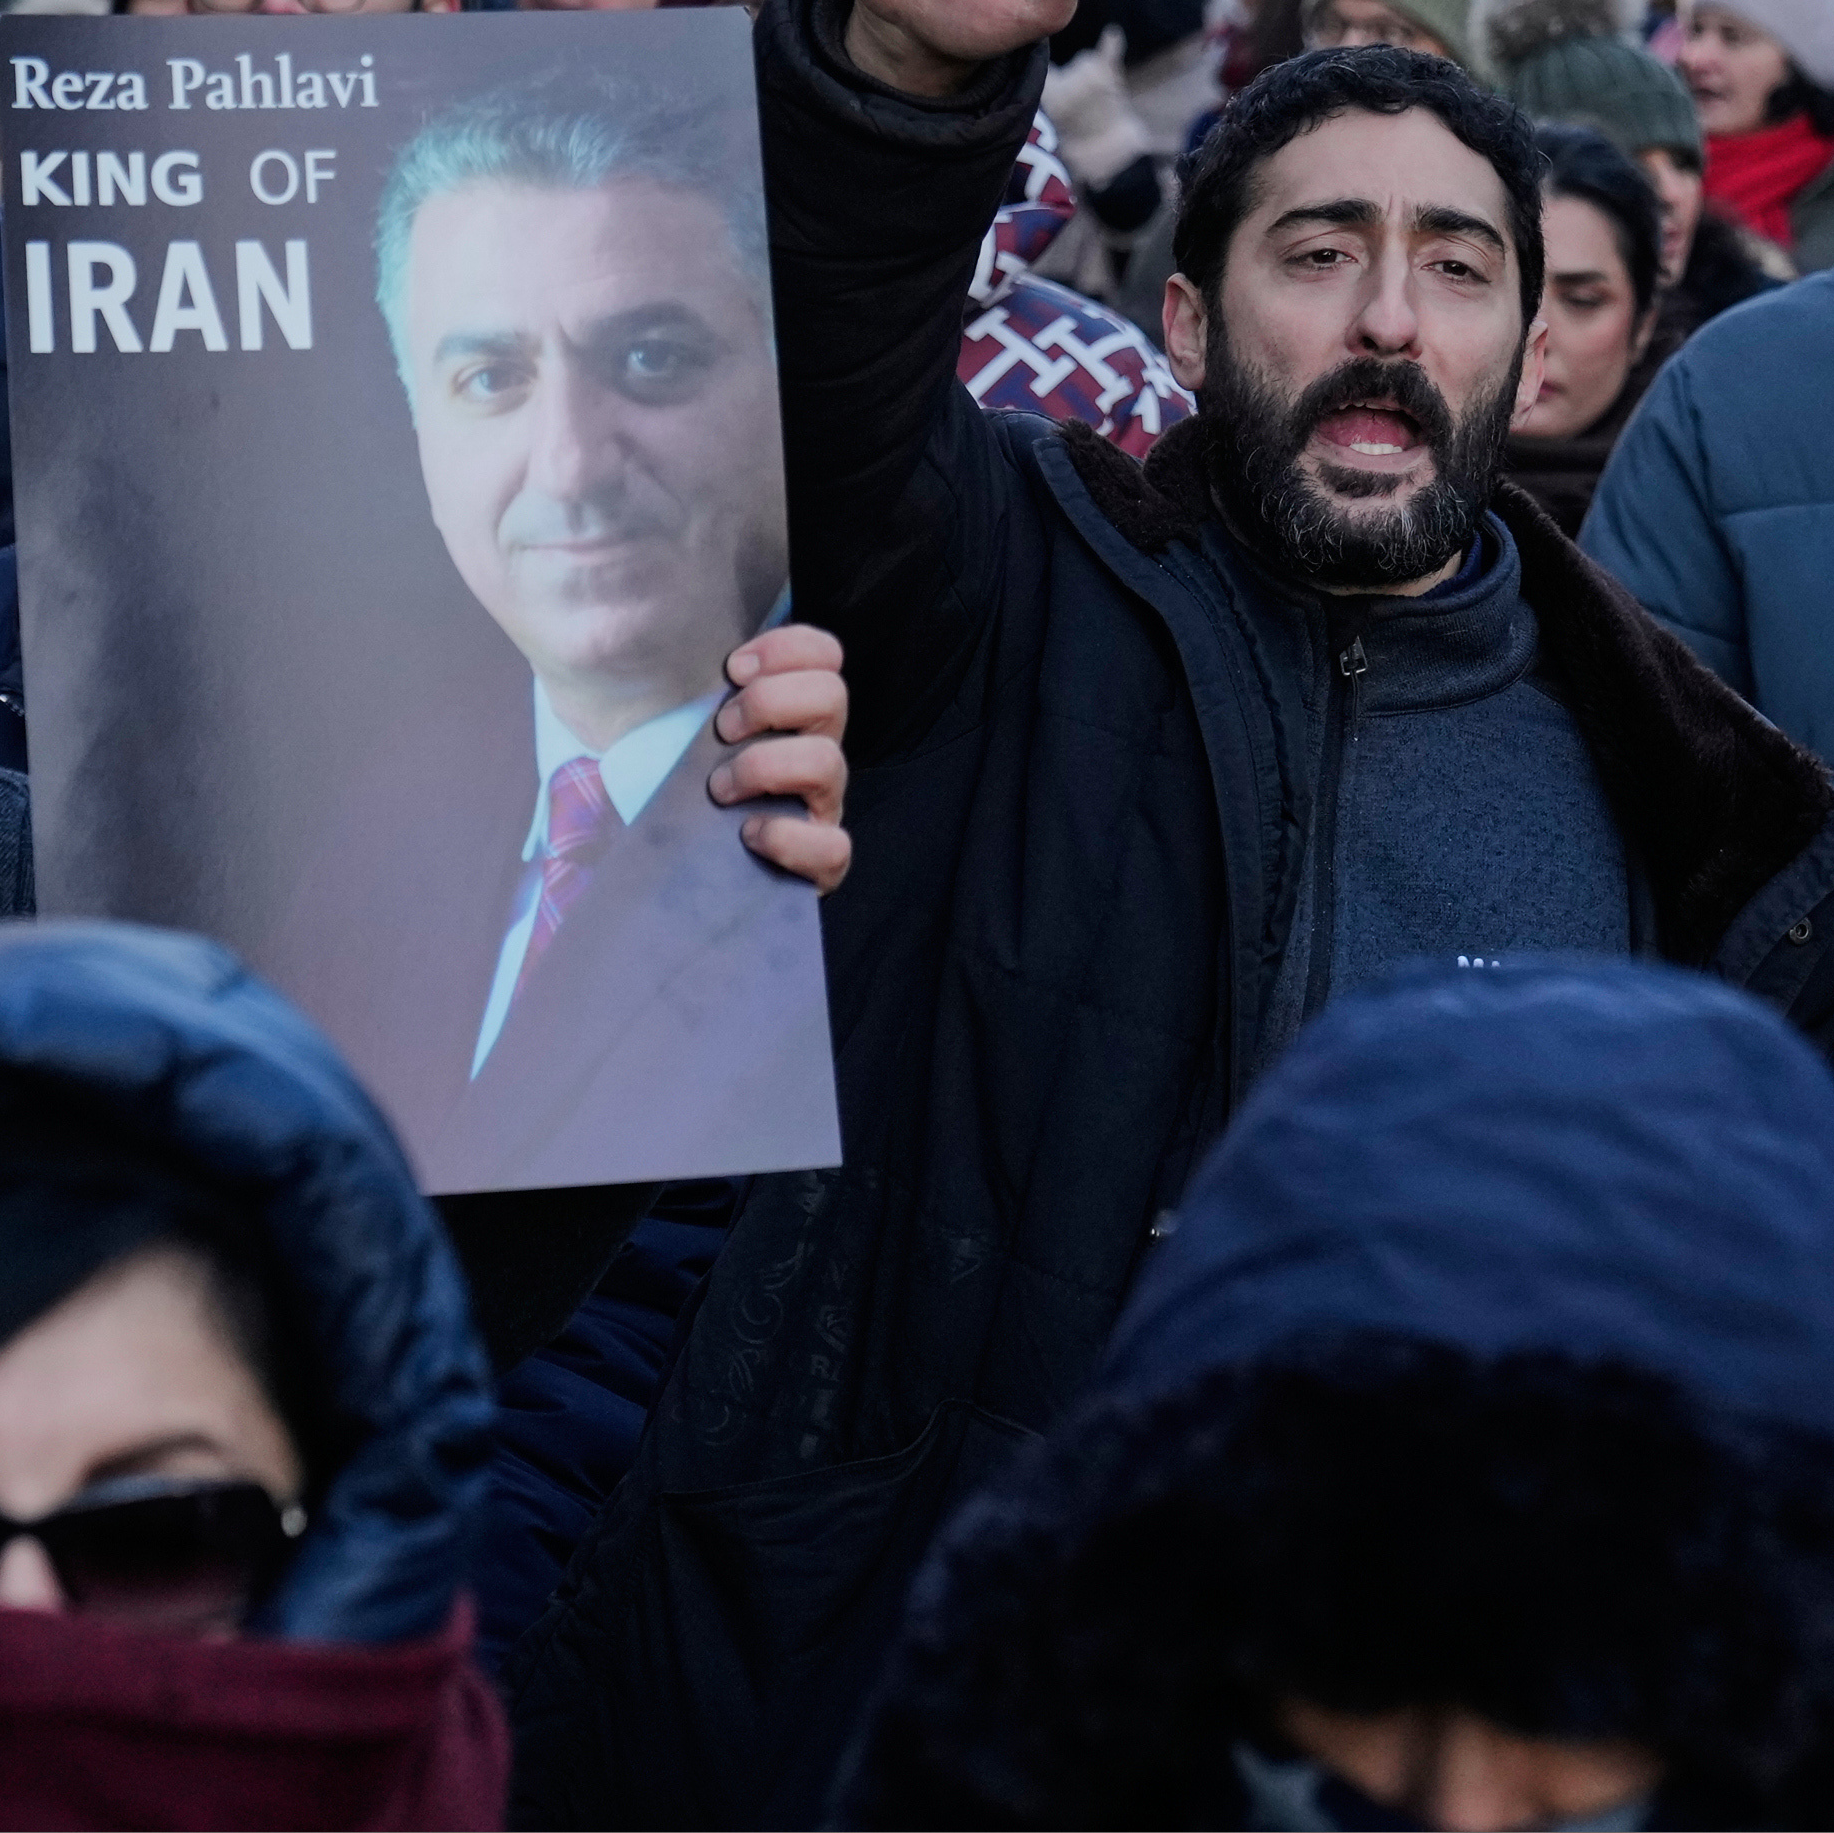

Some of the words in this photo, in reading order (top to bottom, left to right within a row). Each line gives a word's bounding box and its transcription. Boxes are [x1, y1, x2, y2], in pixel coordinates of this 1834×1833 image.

[10, 57, 148, 111] Reza
[167, 54, 379, 110] Pahlavi
[20, 150, 203, 207] KING
[249, 149, 337, 205] OF
[25, 239, 315, 354] IRAN
